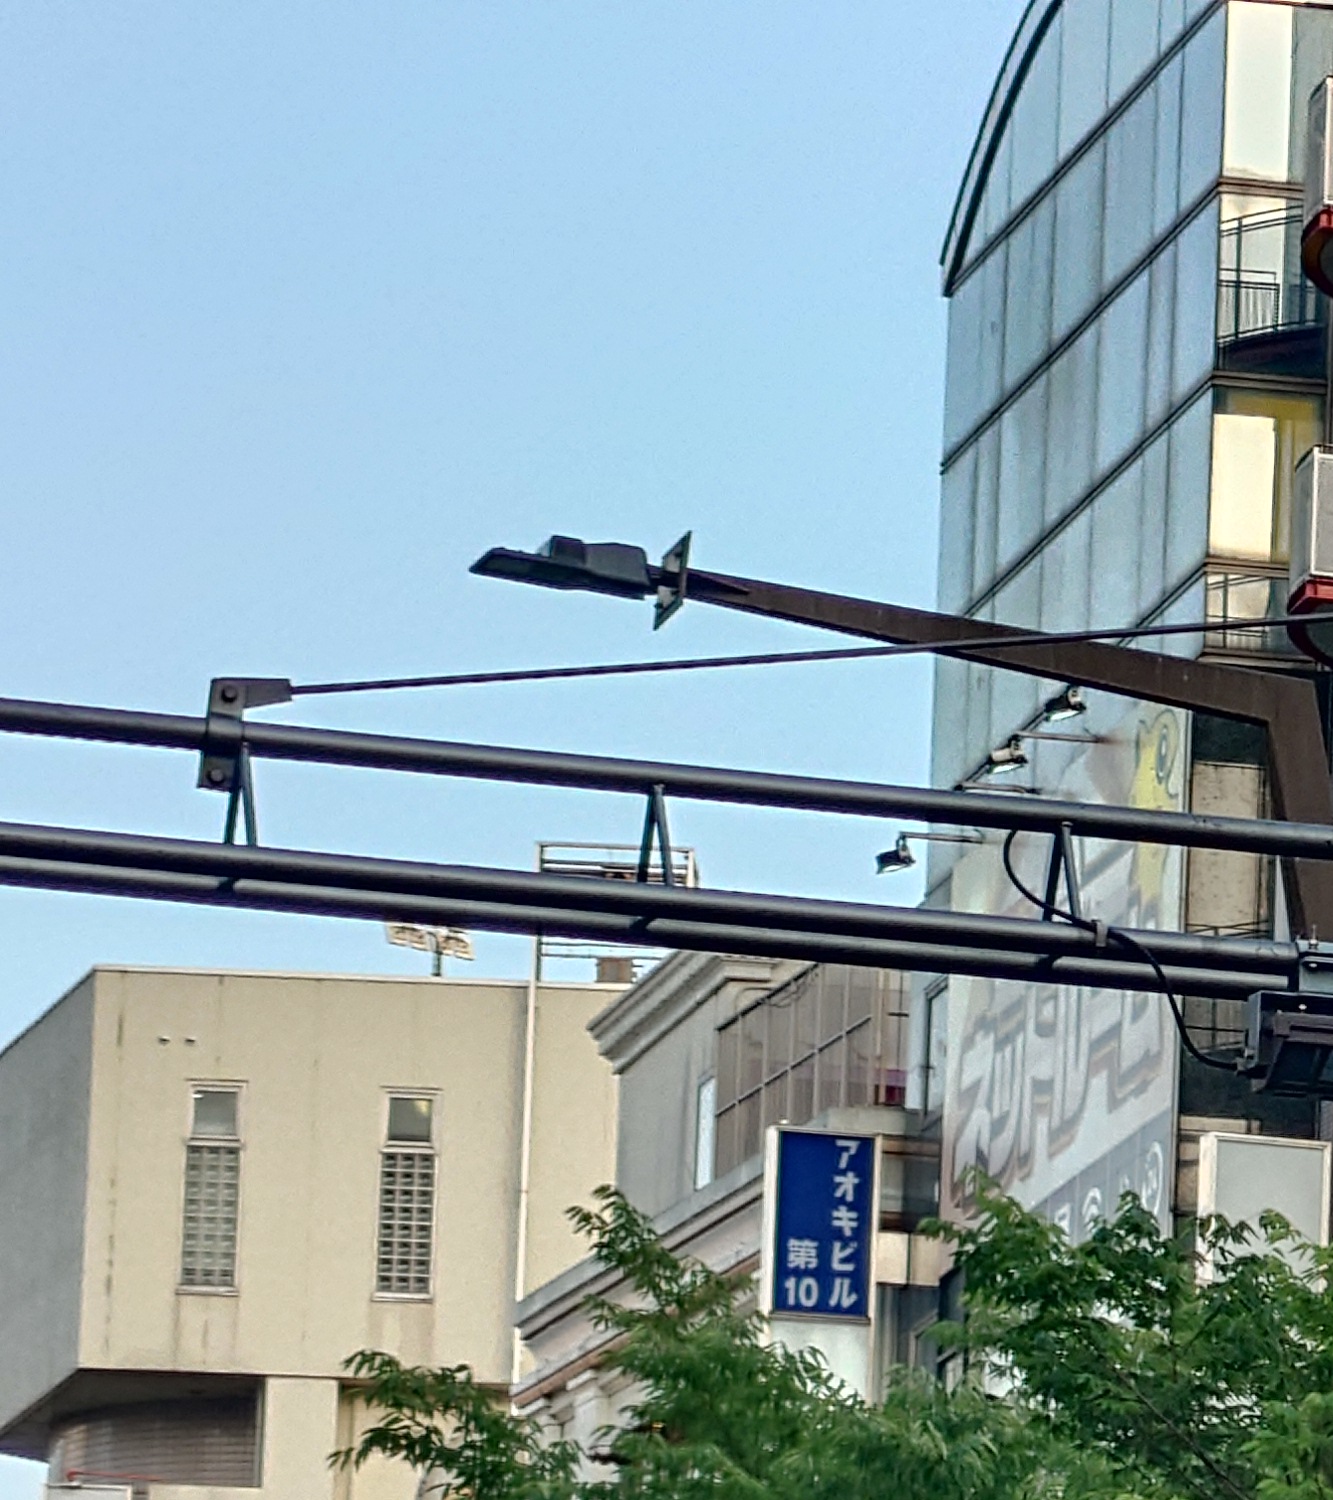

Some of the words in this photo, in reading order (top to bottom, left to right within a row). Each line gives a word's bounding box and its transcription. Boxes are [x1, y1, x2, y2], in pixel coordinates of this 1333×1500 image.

[784, 1237, 819, 1308] 第10
[828, 1138, 862, 1309] アオキビル
